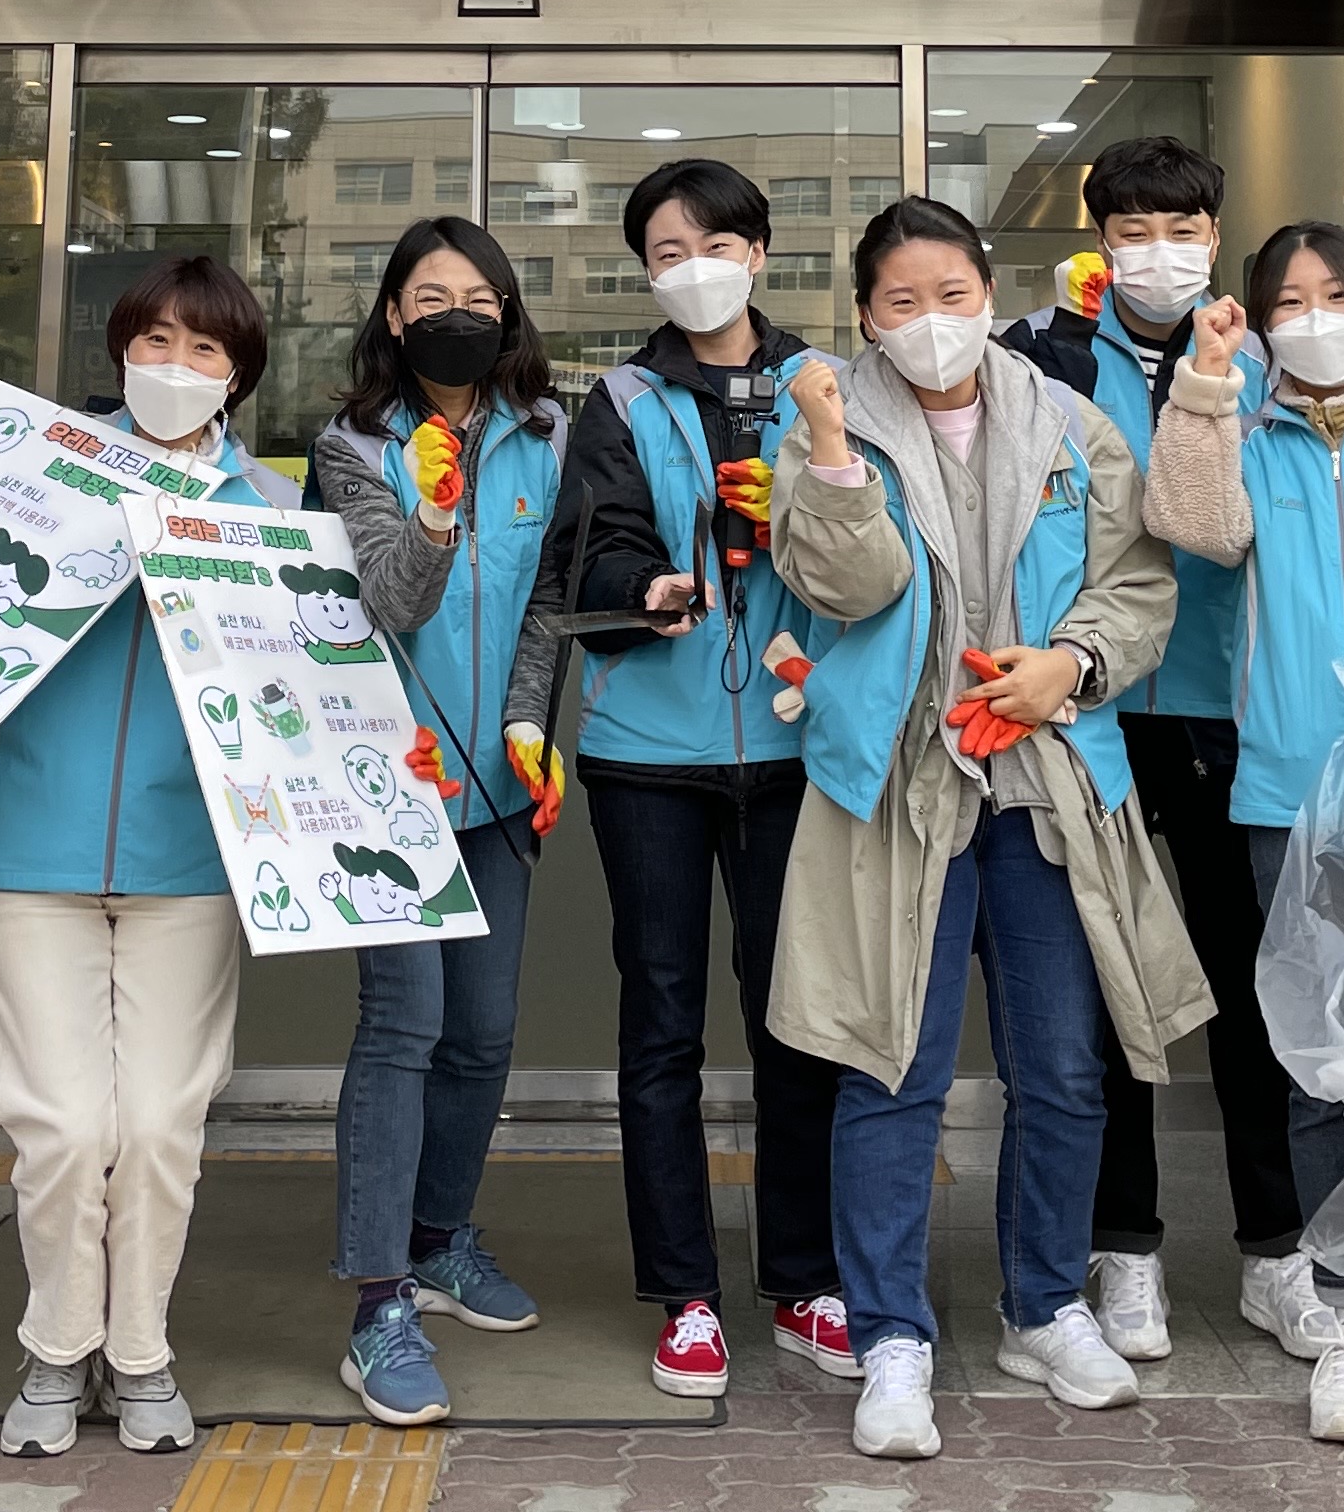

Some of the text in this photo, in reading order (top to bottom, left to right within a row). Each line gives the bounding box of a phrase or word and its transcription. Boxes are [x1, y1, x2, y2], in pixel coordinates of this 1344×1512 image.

[42, 421, 106, 459] 우리는
[98, 444, 150, 475] 지구
[43, 456, 131, 505] 남동장복
[13, 506, 60, 533] 사용하기
[166, 515, 222, 543] 우리는
[220, 521, 260, 546] 지구
[217, 613, 238, 629] 실천
[223, 635, 299, 654] 에코백 사용하기
[320, 695, 340, 709] 실천
[325, 717, 398, 733] 텀블러 사용하기
[285, 776, 306, 792] 실천
[318, 799, 350, 815] 물티슈
[299, 815, 363, 833] 사용하지 않기
